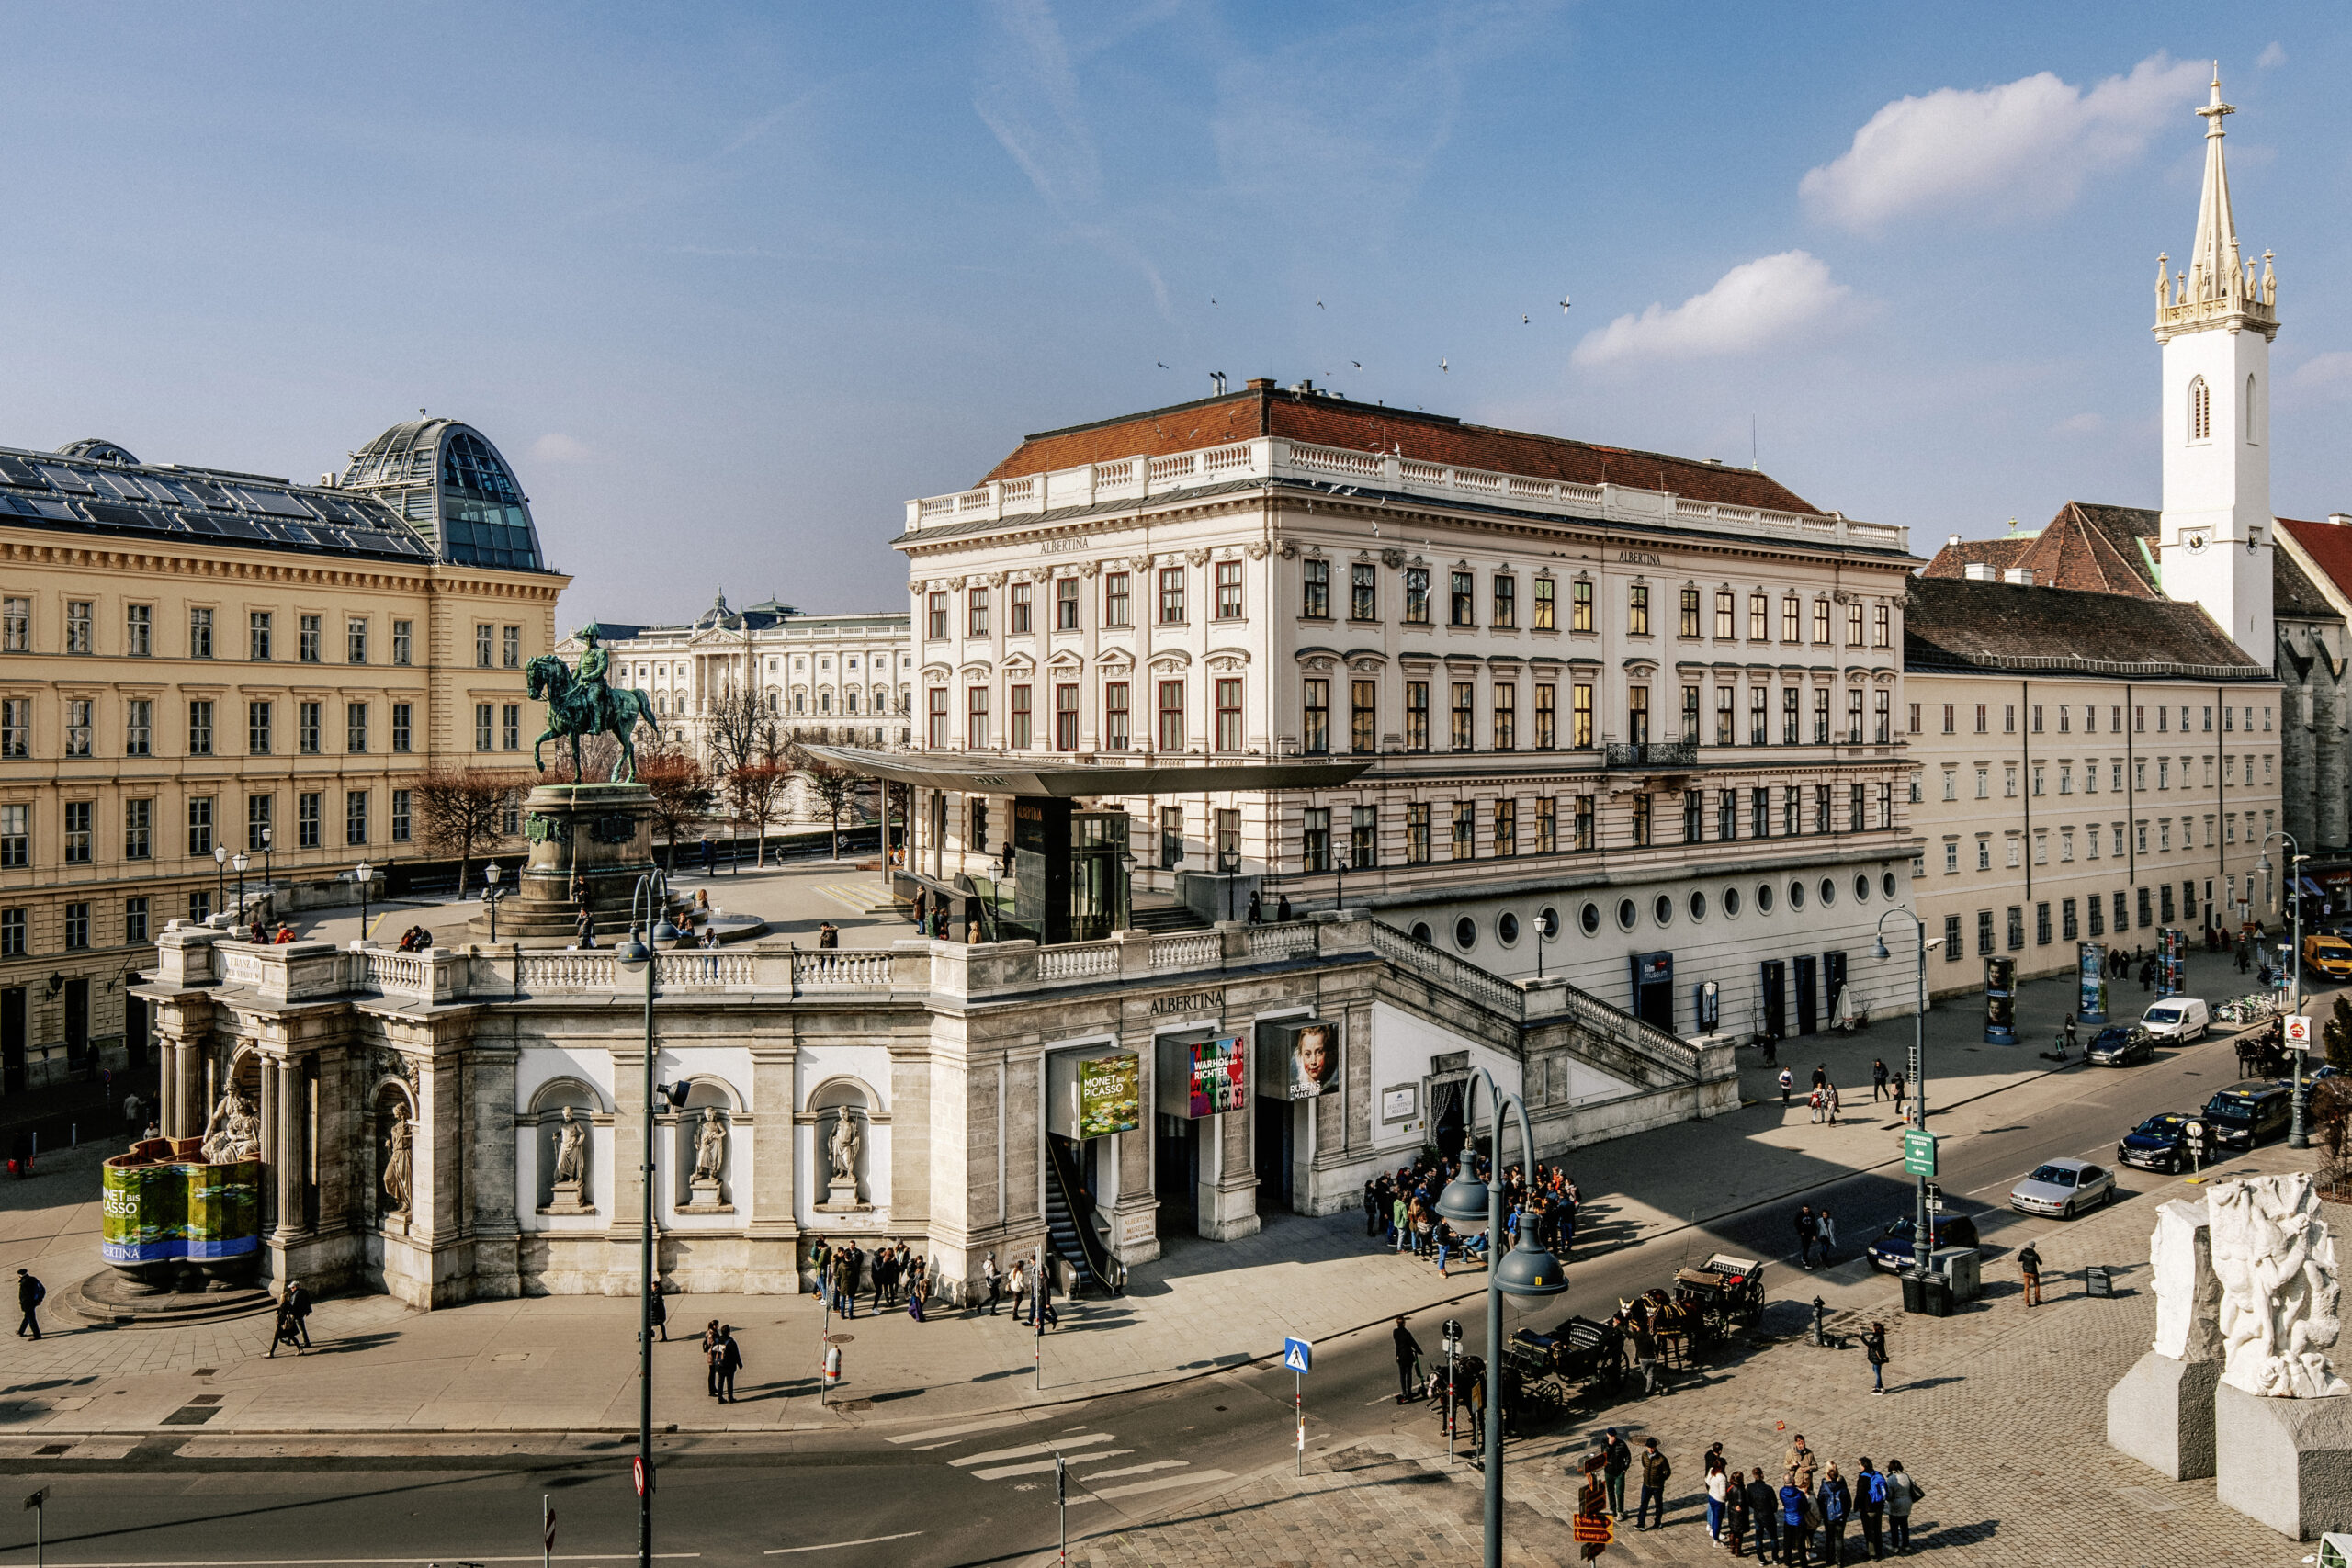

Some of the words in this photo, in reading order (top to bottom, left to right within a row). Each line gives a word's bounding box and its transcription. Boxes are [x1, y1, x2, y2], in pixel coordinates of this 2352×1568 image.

[1040, 536, 1089, 555] ALBERTINA
[1618, 551, 1661, 566] ALBERTINA
[231, 956, 251, 968] FRANZ
[1645, 970, 1668, 979] museum
[1150, 990, 1225, 1015] ALBERTINA
[1194, 1057, 1229, 1071] WARHOL
[1194, 1066, 1228, 1080] RICHTER
[1084, 1074, 1116, 1089] MONET
[1290, 1080, 1321, 1094] RUBENS
[1084, 1083, 1124, 1099] PICASSO
[1294, 1089, 1321, 1100] MAKART
[126, 1194, 141, 1202] BIS
[1125, 1213, 1153, 1226] ALBERTINA
[1126, 1224, 1150, 1234] MUSEUM
